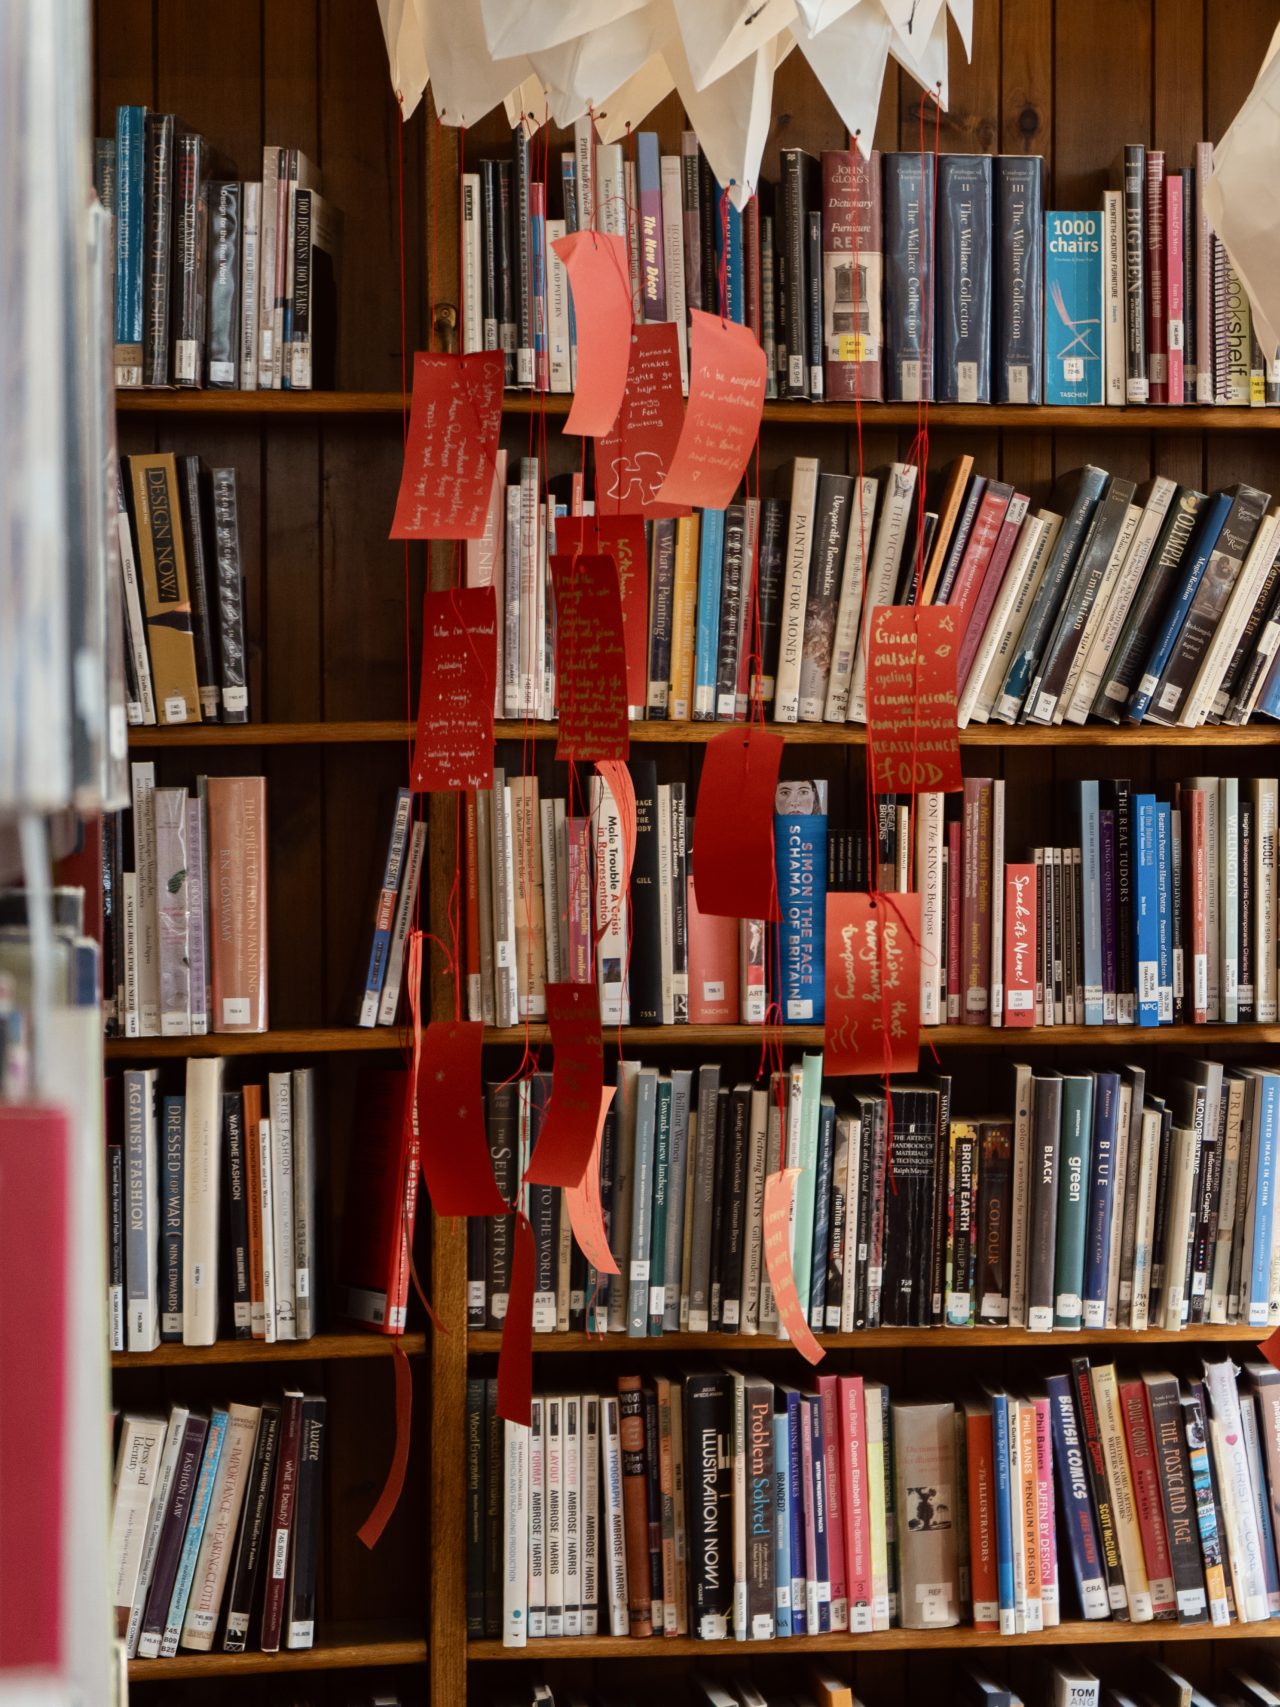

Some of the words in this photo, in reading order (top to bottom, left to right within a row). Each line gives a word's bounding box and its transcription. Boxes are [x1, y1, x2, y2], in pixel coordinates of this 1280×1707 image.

[218, 190, 228, 216] Design
[908, 200, 918, 224] The
[960, 201, 971, 224] The
[1013, 201, 1024, 224] The
[220, 218, 228, 229] for
[220, 230, 228, 243] the
[1053, 218, 1097, 235] 1000
[1126, 207, 1142, 246] BIG
[219, 244, 228, 263] Real
[908, 228, 918, 273] Wallace
[960, 228, 970, 273] Wallace
[1012, 228, 1024, 273] Wallace
[1048, 236, 1100, 254] chairs
[219, 264, 227, 285] World
[1127, 250, 1142, 293] BEN
[907, 277, 919, 338] Collection
[960, 277, 970, 338] Collection
[1012, 277, 1023, 339] Collection
[148, 470, 170, 540] DESIGN
[660, 535, 672, 569] What
[791, 514, 807, 580] PAINTING
[1158, 513, 1196, 567] OLYMPIA
[158, 545, 176, 600] NOW!
[658, 571, 669, 583] is
[655, 586, 669, 641] Painting?
[789, 584, 802, 610] FOR
[1072, 569, 1103, 631] Emulation
[784, 616, 799, 666] MONEY
[398, 800, 408, 812] THE
[887, 804, 896, 832] GREAT
[1118, 790, 1128, 815] THE
[392, 814, 407, 845] CULTURE
[607, 816, 618, 845] Male
[879, 804, 887, 840] BRITONS
[1119, 820, 1128, 848] REAL
[1157, 812, 1166, 837] Beatrix
[391, 847, 402, 859] OF
[789, 825, 801, 897] SCHAMA
[1157, 838, 1166, 861] Potter
[1227, 815, 1237, 897] WELLINGTON
[386, 860, 400, 886] DESIGN
[609, 848, 619, 890] Trouble
[802, 842, 813, 897] SIMON
[1119, 852, 1129, 903] TUDORS
[1158, 870, 1167, 891] Harry
[383, 892, 393, 906] GUY
[611, 894, 619, 902] A
[1158, 892, 1167, 914] Potter
[379, 907, 391, 930] JULIER
[610, 906, 621, 936] Crisis
[788, 907, 800, 930] OF
[801, 908, 813, 937] THE
[788, 935, 801, 999] BRITAIN
[801, 943, 813, 985] FACE
[130, 1082, 142, 1153] AGAINST
[659, 1096, 670, 1133] Towards
[939, 1095, 948, 1136] SHADOWS
[1227, 1091, 1241, 1152] PRINTS
[1265, 1105, 1273, 1138] PRINTED
[167, 1105, 182, 1172] DRESSED
[229, 1114, 239, 1156] WARTIME
[657, 1142, 666, 1161] new
[753, 1131, 766, 1173] Picturing
[1263, 1141, 1272, 1166] IMAGE
[231, 1159, 241, 1200] FASHION
[961, 1144, 972, 1188] BRIGHT
[1043, 1146, 1053, 1184] BLACK
[1068, 1157, 1082, 1202] green
[1097, 1141, 1110, 1186] BLUE
[1205, 1151, 1215, 1191] Information
[1263, 1169, 1270, 1178] IN
[131, 1159, 142, 1230] FASHION
[169, 1175, 178, 1194] FOR
[540, 1188, 551, 1206] TO
[655, 1164, 667, 1206] landscape
[753, 1175, 764, 1218] PLANTS
[1261, 1181, 1269, 1207] CHINA
[168, 1196, 181, 1227] WAR
[540, 1209, 551, 1236] THE
[960, 1192, 970, 1231] EARTH
[1202, 1192, 1212, 1224] Graphics
[752, 1226, 761, 1241] Gill
[987, 1199, 1000, 1265] COLOUR
[168, 1244, 178, 1266] NINA
[540, 1239, 551, 1290] WORLD
[749, 1242, 760, 1283] Saunders
[168, 1268, 178, 1312] EDWARDS
[1022, 1414, 1031, 1437] PHIL
[1058, 1395, 1080, 1445] BRITISH
[126, 1436, 142, 1473] Identity
[140, 1437, 155, 1465] Dress
[308, 1420, 323, 1461] Aware
[751, 1402, 769, 1476] Problem
[1023, 1439, 1033, 1474] BAINES
[137, 1467, 149, 1486] and
[177, 1452, 194, 1495] FASHION
[532, 1450, 541, 1487] FORMAT
[550, 1450, 558, 1484] LAYOUT
[568, 1449, 576, 1485] COLOUR
[609, 1449, 620, 1509] TYPOGRAPHY
[701, 1428, 717, 1534] ILLUSTRATION
[1067, 1452, 1086, 1500] COMICS
[173, 1496, 187, 1518] LAW
[752, 1478, 770, 1535] Solved
[776, 1471, 786, 1512] BRANDED?
[1024, 1480, 1034, 1527] PENGUIN
[1039, 1482, 1048, 1518] PUFFIN
[532, 1492, 541, 1536] AMBROSE
[550, 1490, 559, 1534] AMBROSE
[567, 1491, 577, 1535] AMBROSE
[1040, 1520, 1049, 1536] BY
[1099, 1504, 1108, 1529] SCOTT
[612, 1514, 623, 1558] AMBROSE
[1026, 1531, 1035, 1545] BY
[1101, 1530, 1117, 1567] McCLOUD
[532, 1543, 541, 1577] HARRIS
[550, 1541, 559, 1575] HARRIS
[567, 1542, 577, 1576] HARRIS
[704, 1538, 719, 1590] NOW!
[1027, 1547, 1037, 1585] DESIGN
[1040, 1538, 1051, 1579] DESIGN
[615, 1565, 625, 1599] HARRIS
[1070, 1688, 1095, 1697] TOM
[1070, 1698, 1095, 1707] ANG
